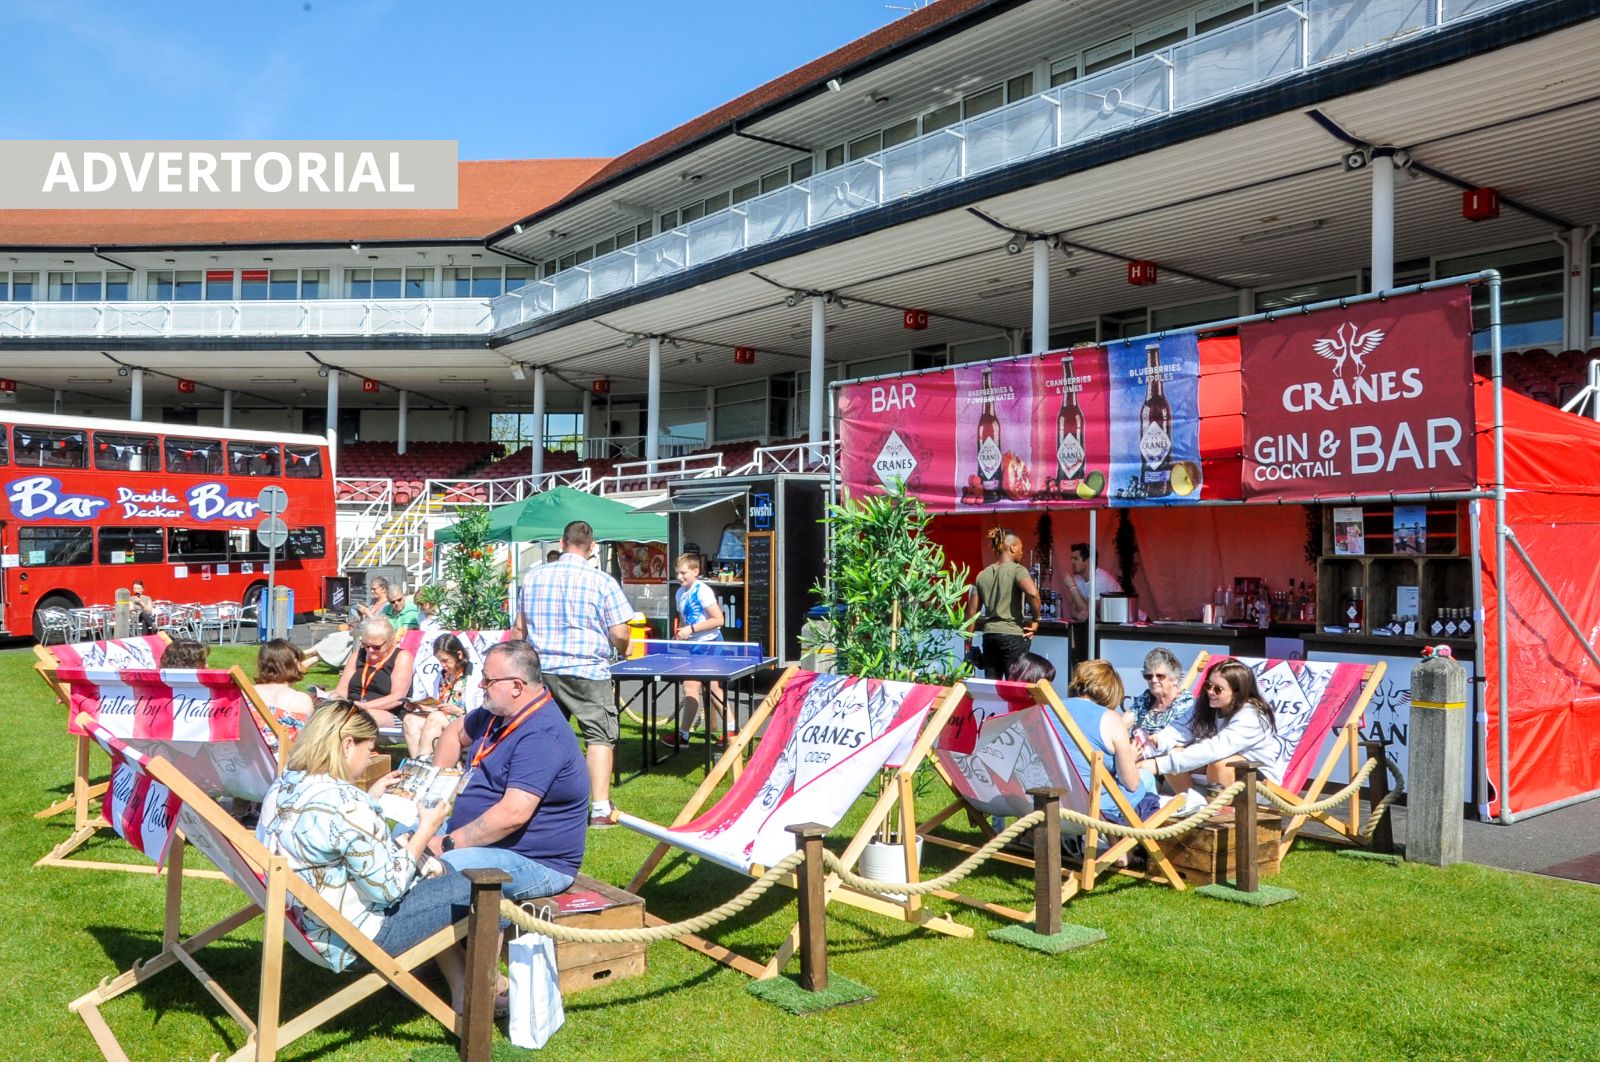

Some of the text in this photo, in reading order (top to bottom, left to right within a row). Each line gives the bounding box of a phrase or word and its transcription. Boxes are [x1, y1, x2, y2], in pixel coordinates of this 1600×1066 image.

[1131, 266, 1141, 278] H
[1146, 266, 1154, 278] H
[906, 313, 913, 324] G
[918, 313, 925, 325] G
[1129, 363, 1182, 377] BLUEBERRIES
[1045, 375, 1092, 387] CRANBERRIES
[1145, 373, 1174, 384] APPLES
[1063, 384, 1083, 394] LIMES
[1282, 368, 1423, 412] CRANES
[871, 382, 917, 413] BAR
[1143, 440, 1169, 450] CRANES
[1254, 430, 1341, 464] GIN &
[1350, 417, 1462, 475] BAR
[1060, 451, 1082, 460] CRANES
[877, 459, 913, 471] CRANES
[1254, 460, 1341, 482] COCKTAIL
[9, 477, 105, 517] Bar
[116, 487, 178, 504] Double
[189, 483, 260, 519] Bar
[123, 502, 184, 519] Decker
[79, 692, 137, 715] Chilled
[142, 696, 160, 727] by
[802, 725, 865, 748] CRANES
[804, 751, 832, 764] CIDER
